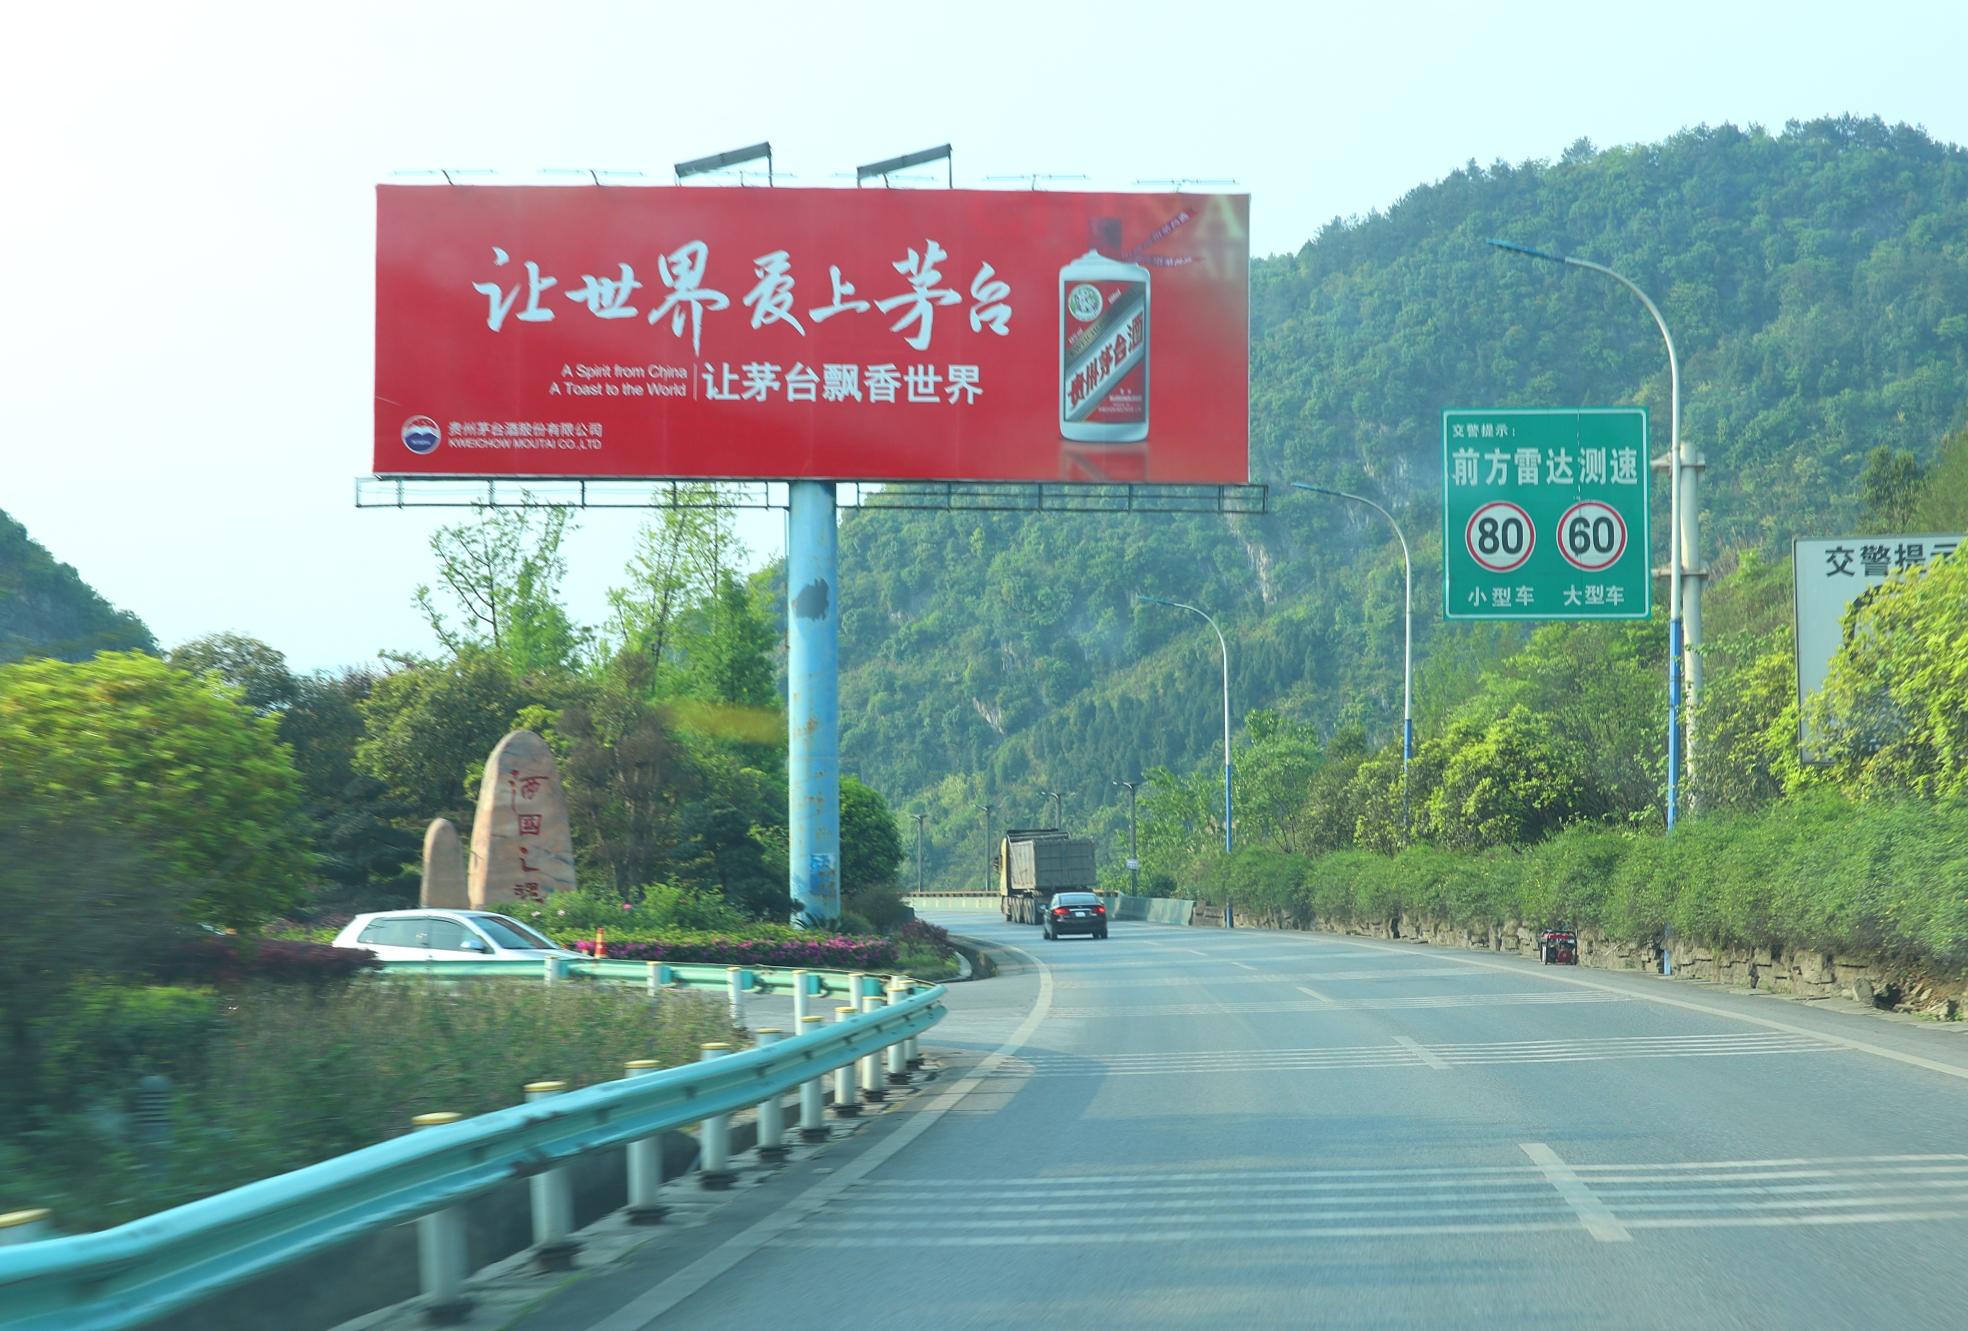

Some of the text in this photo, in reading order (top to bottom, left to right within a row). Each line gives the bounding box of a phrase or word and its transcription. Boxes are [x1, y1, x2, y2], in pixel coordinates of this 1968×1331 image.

[471, 239, 1012, 357] 让世界爱上茅台
[561, 363, 688, 380] A Spirit from China
[549, 381, 687, 397] A Toast to the World
[702, 361, 983, 405] 让茅台飘香世界
[448, 421, 603, 437] 贵州茅台酒股份有限公司
[448, 438, 511, 449] KWEICHOW
[513, 438, 556, 449] MOUTAI
[1452, 446, 1639, 486] 前方雷达测速
[1478, 517, 1524, 555] 80
[1569, 516, 1615, 555] 60
[1468, 586, 1535, 607] 小型车
[1563, 584, 1625, 606] 大型车
